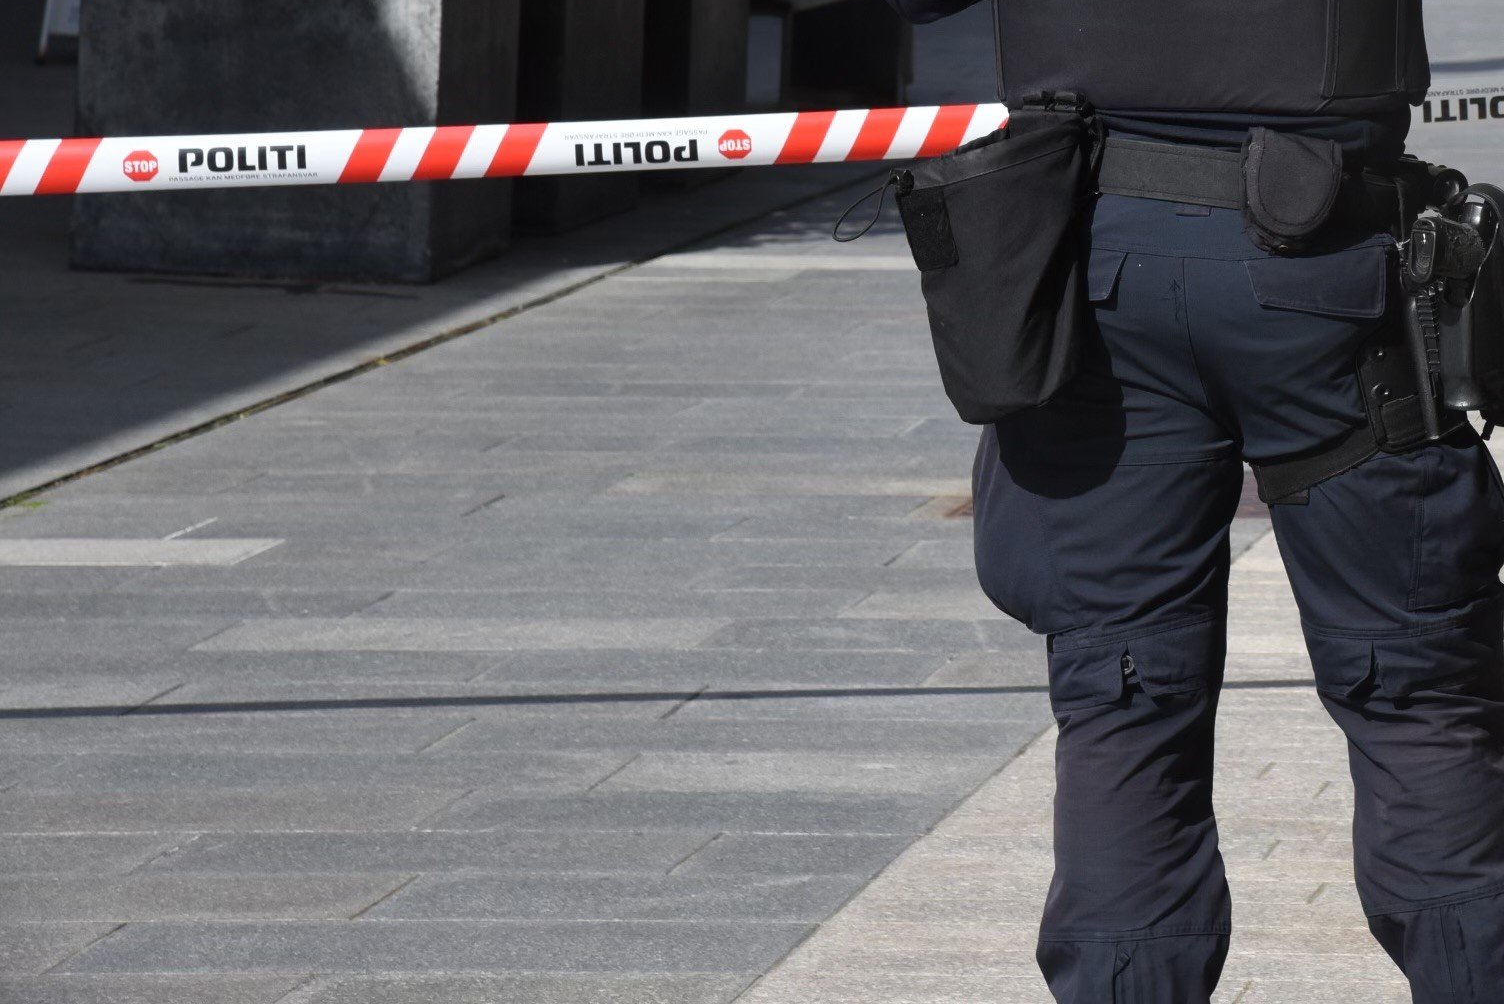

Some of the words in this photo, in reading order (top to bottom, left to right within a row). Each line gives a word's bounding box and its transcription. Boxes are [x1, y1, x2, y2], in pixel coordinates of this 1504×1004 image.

[575, 139, 699, 166] POLITI
[719, 139, 750, 151] STOP
[124, 159, 158, 173] STOP
[178, 144, 307, 173] POLITI
